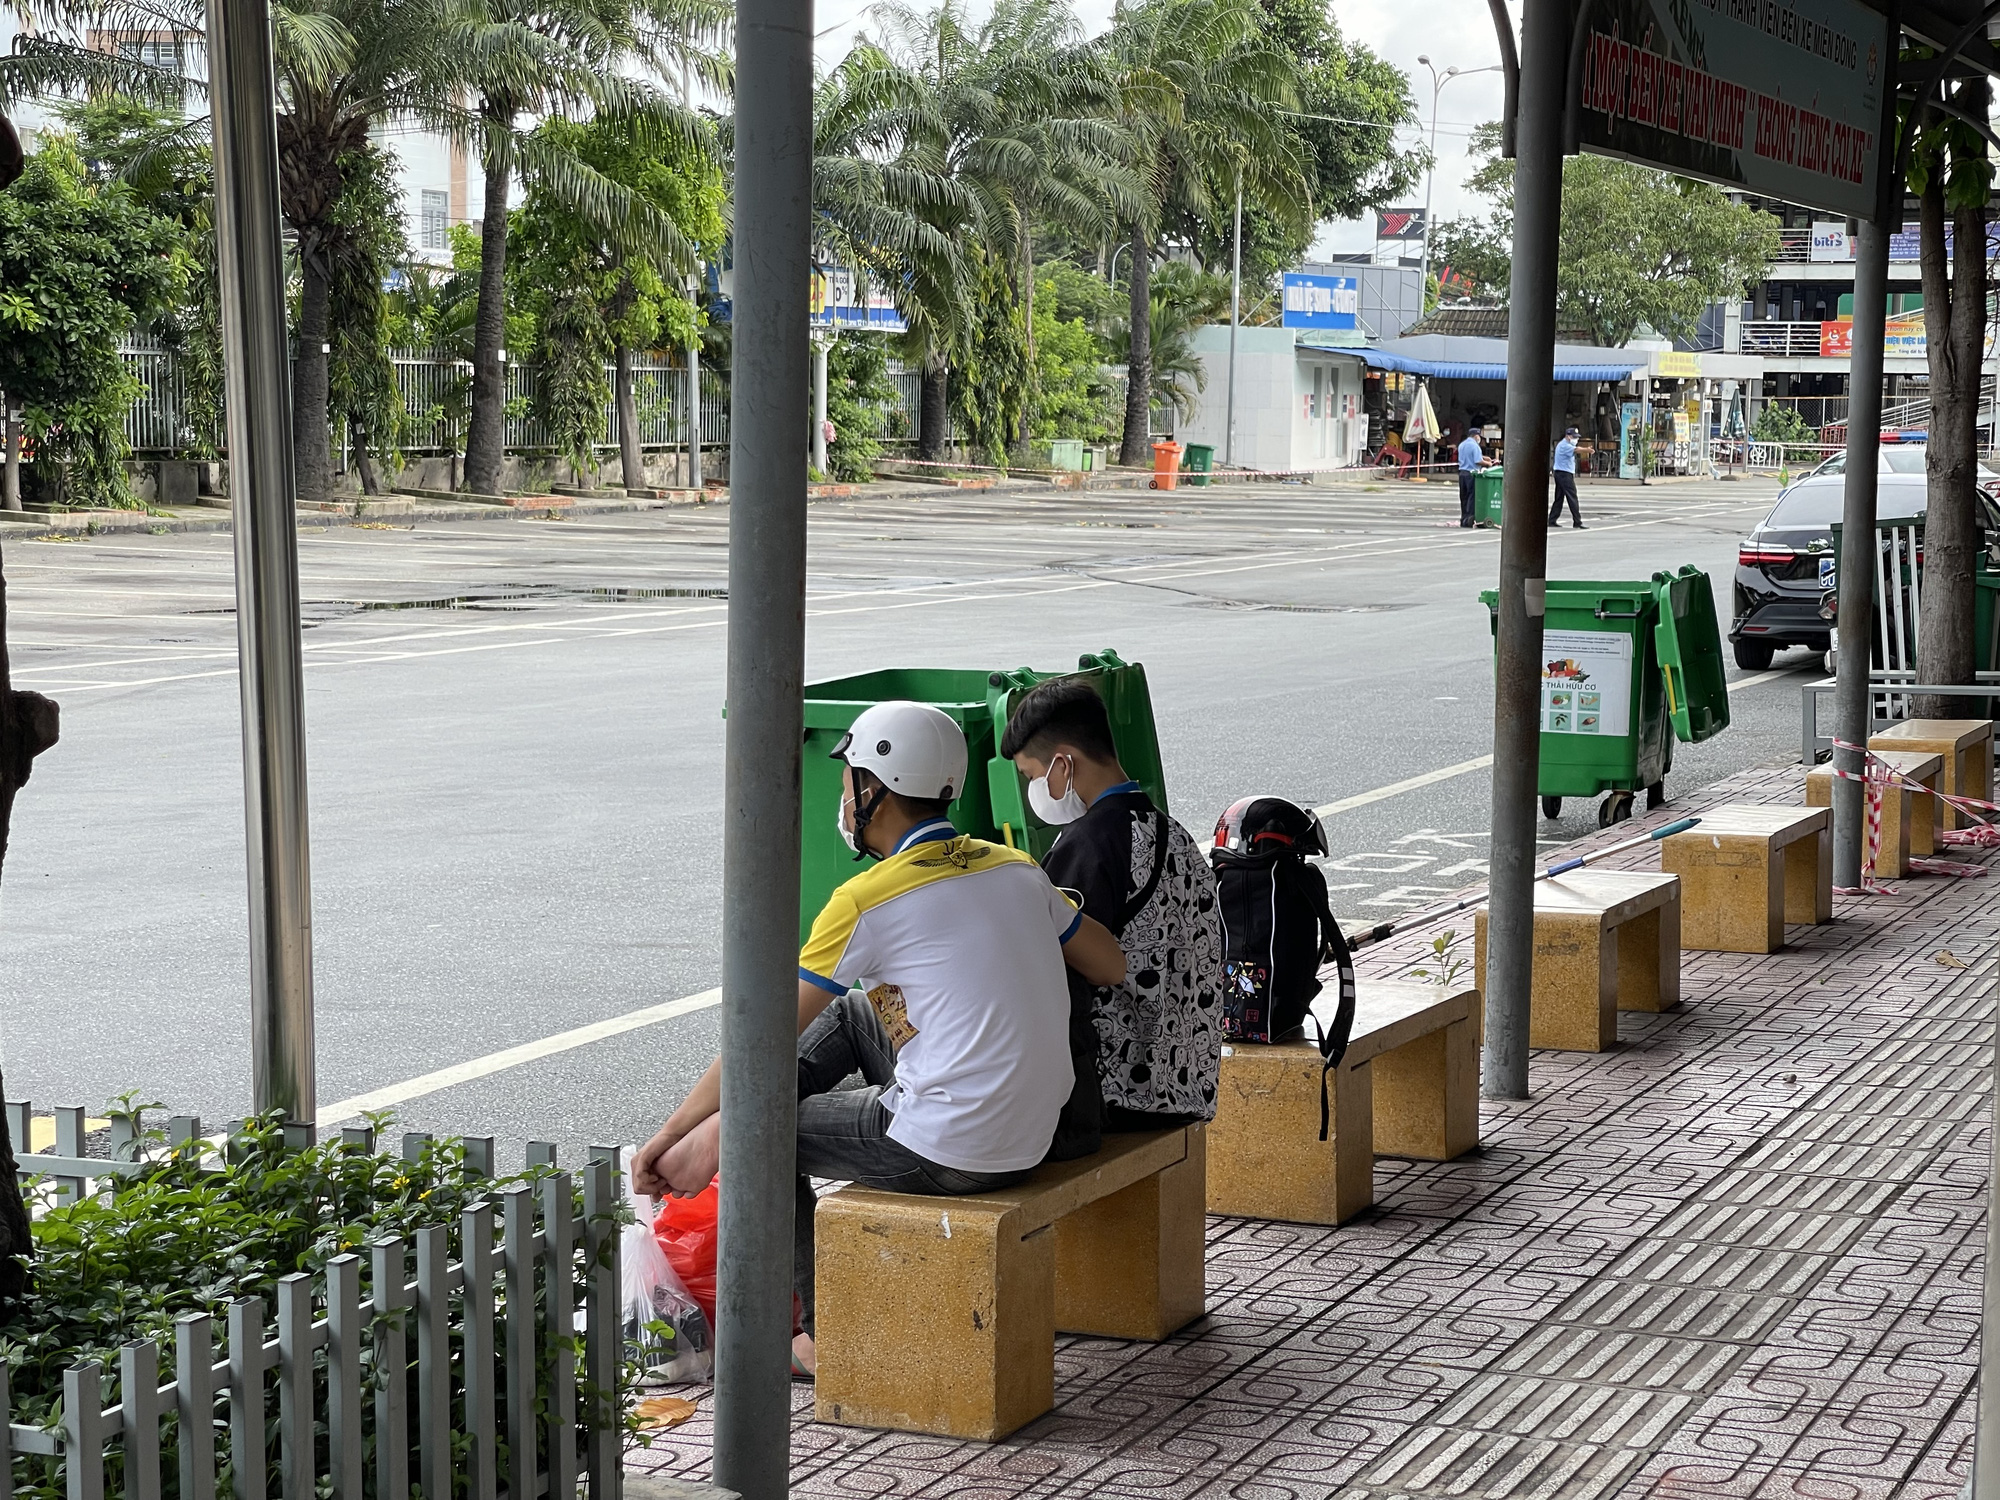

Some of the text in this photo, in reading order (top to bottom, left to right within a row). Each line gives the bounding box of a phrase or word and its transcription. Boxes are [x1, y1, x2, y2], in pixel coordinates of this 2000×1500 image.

[1780, 0, 1800, 46] BẾN
[1800, 15, 1813, 52] XE
[1813, 13, 1834, 61] MIỀN
[1834, 28, 1858, 71] ĐÔNG
[1592, 18, 1631, 135] MỘT
[1627, 22, 1662, 129] BẾN
[1659, 55, 1684, 136] XE
[1682, 53, 1715, 144] VĂN
[1710, 76, 1748, 151] MINH
[1796, 88, 1831, 176] TIẾNG
[1830, 103, 1852, 181] CÒI
[1585, 683, 1597, 691] CƠ
